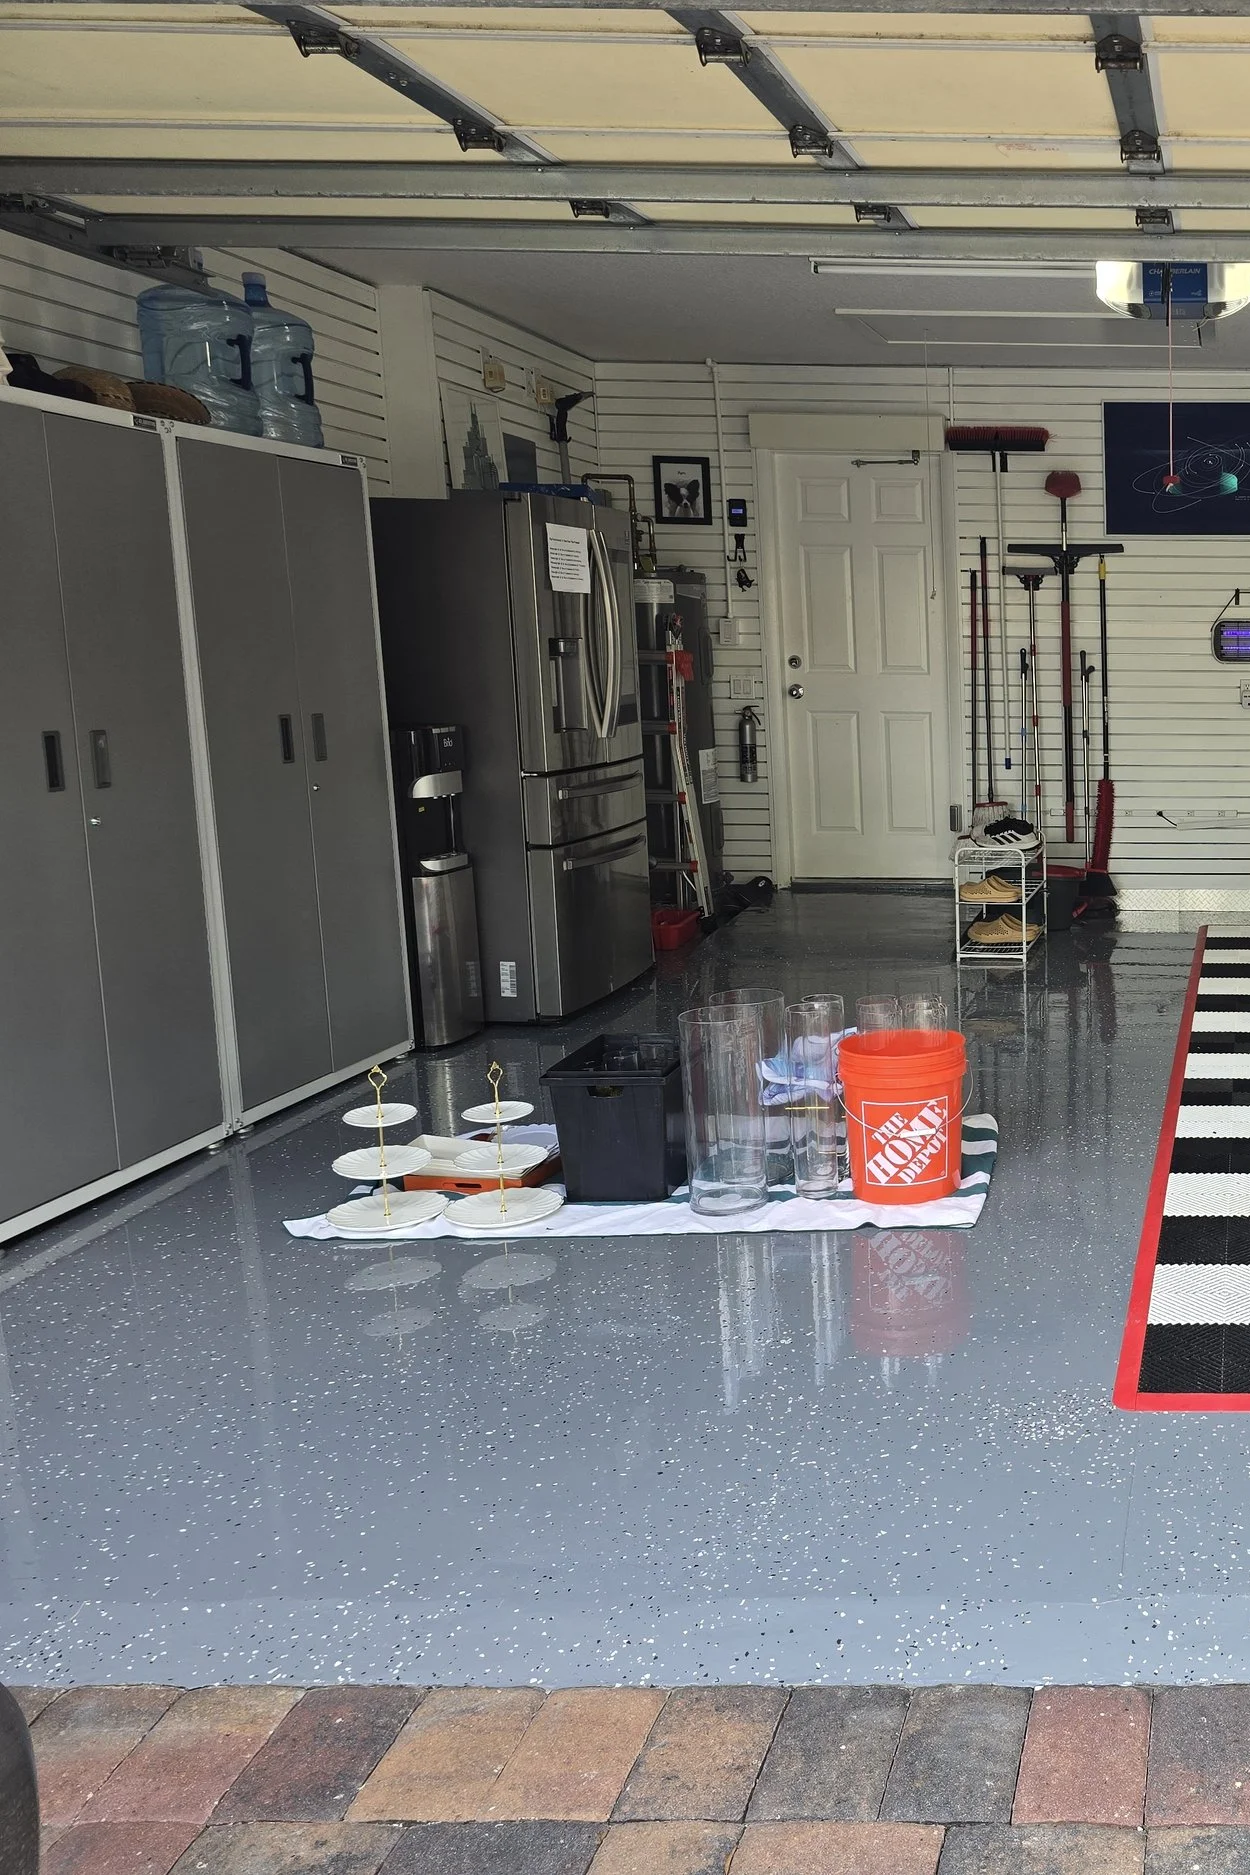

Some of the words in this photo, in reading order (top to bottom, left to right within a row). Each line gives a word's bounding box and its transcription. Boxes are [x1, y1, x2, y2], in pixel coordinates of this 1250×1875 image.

[867, 1100, 947, 1184] HOME
[871, 1112, 908, 1146] THE
[898, 1128, 948, 1184] DEPOT
